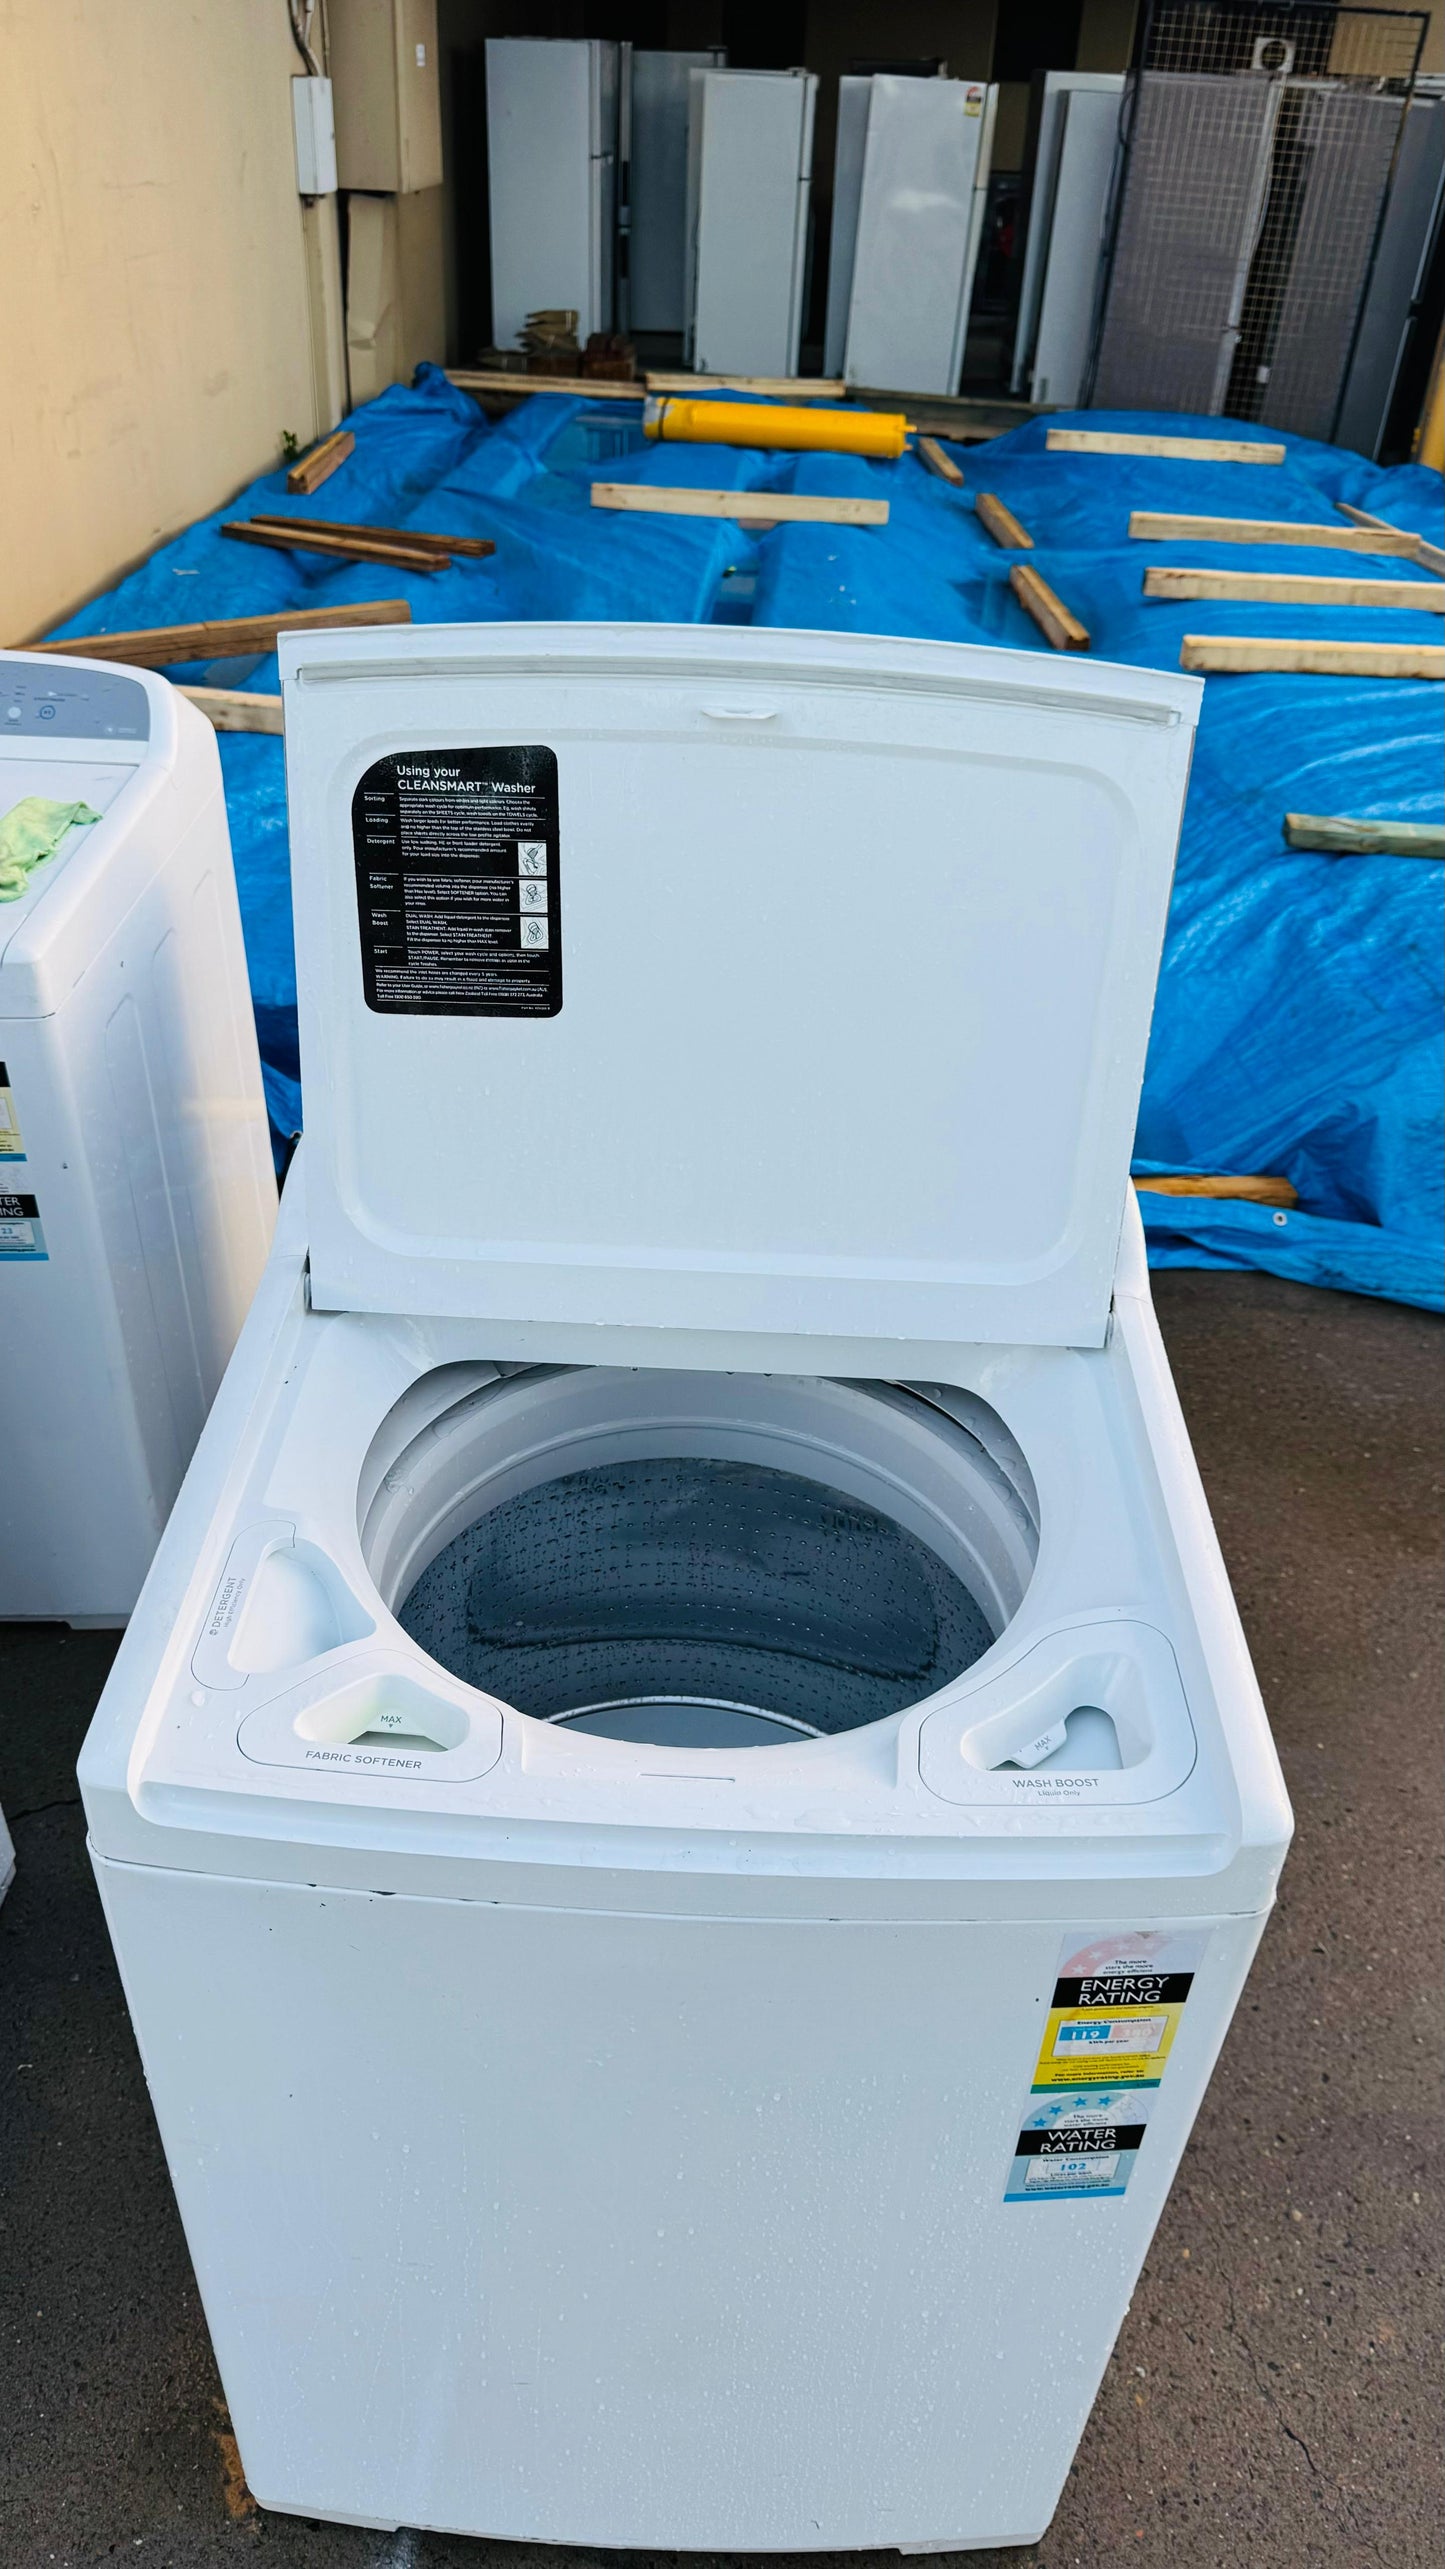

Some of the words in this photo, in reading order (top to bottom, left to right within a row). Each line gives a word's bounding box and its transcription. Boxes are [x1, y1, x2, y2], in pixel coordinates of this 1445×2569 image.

[397, 765, 430, 778] Using
[434, 768, 460, 779] your
[491, 782, 536, 794] Washer
[211, 1577, 237, 1628] DETERGENT
[380, 1715, 402, 1724] MAX
[1034, 1735, 1052, 1751] MAX
[305, 1750, 352, 1763] FABRIC
[354, 1755, 422, 1769] SOFTENER
[1012, 1779, 1052, 1788] WASH
[1055, 1778, 1099, 1788] BOOST
[1080, 1977, 1170, 1992] ENERGY
[1078, 1990, 1161, 2005] RATING
[1072, 2030, 1100, 2040] 119
[1048, 2128, 1117, 2141] WATER
[1040, 2139, 1117, 2153] RATING
[1060, 2162, 1087, 2171] 102
